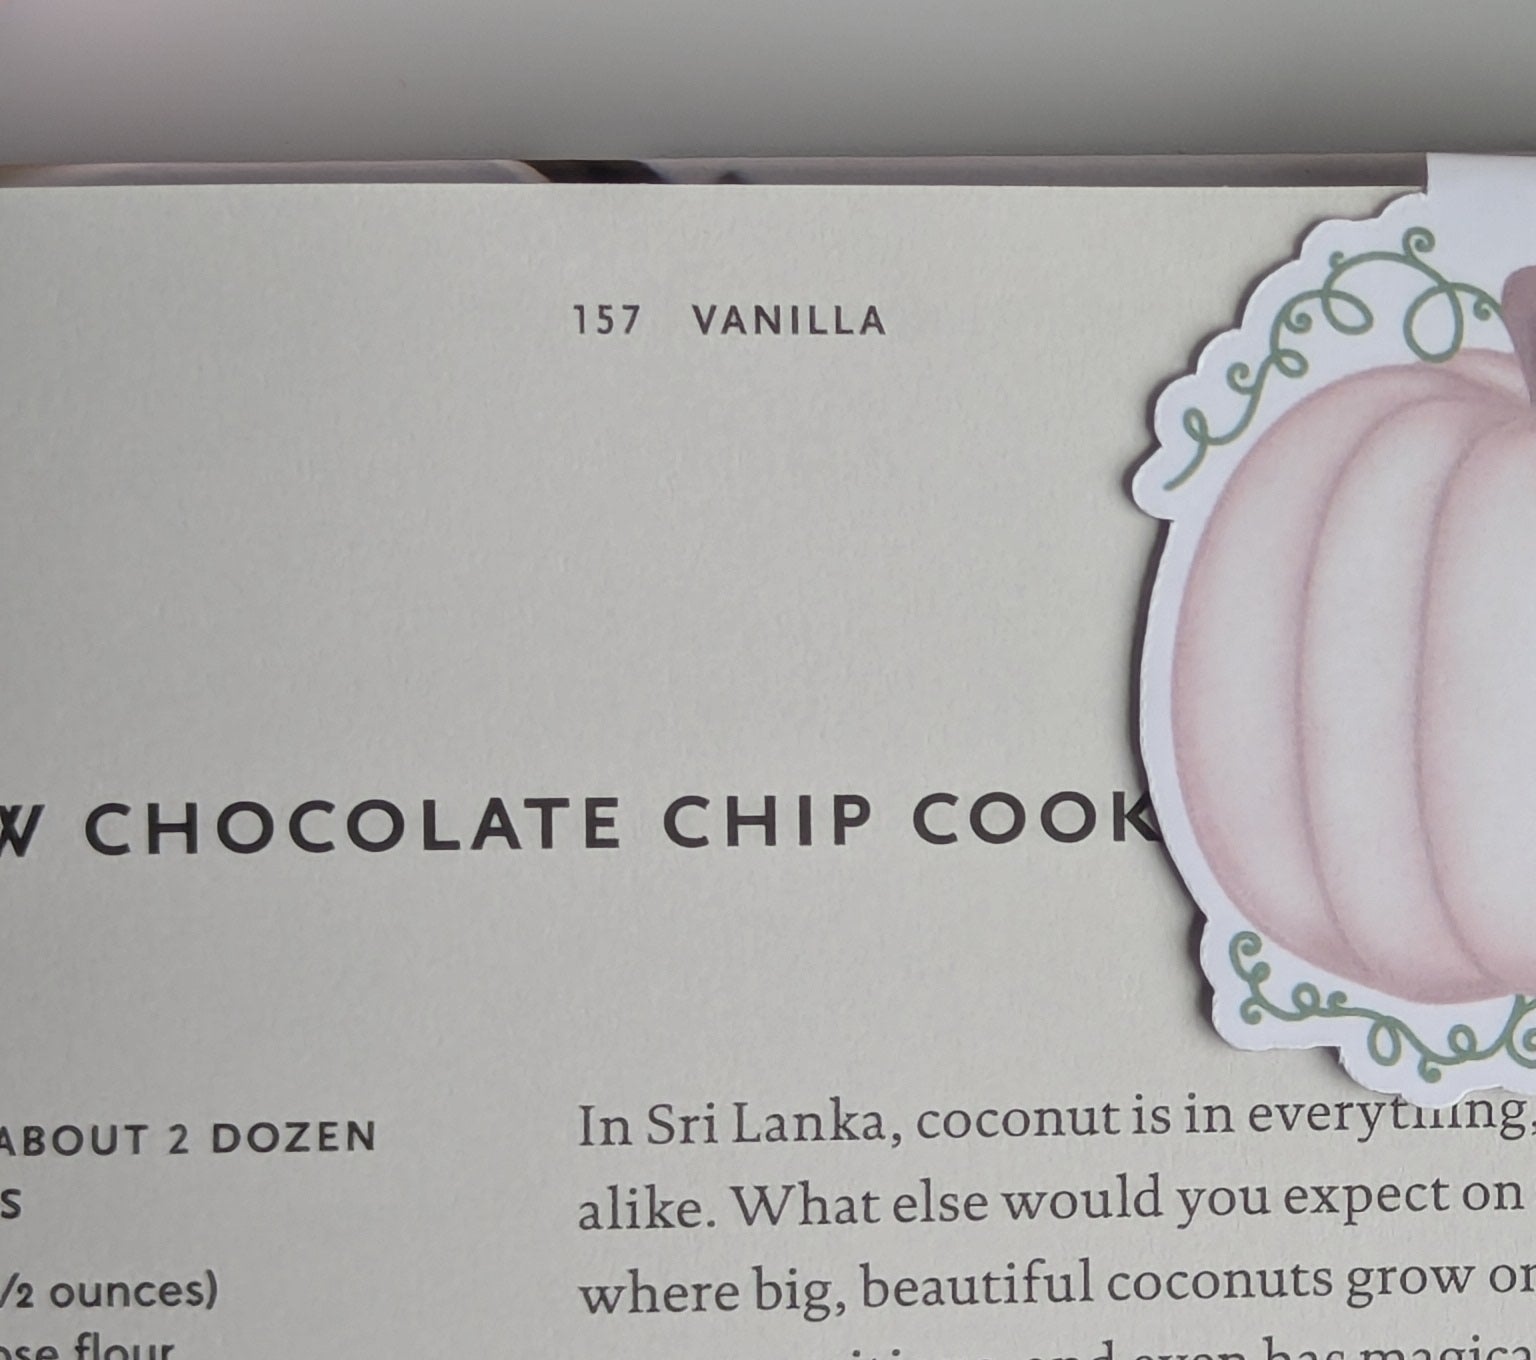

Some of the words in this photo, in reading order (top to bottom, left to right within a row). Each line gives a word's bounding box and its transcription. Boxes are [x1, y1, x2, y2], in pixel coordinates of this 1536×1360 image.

[573, 304, 640, 334] 157
[692, 304, 885, 335] VANILLA
[85, 797, 619, 856] CHOCOLATE
[663, 794, 871, 848] CHIP
[169, 1124, 188, 1154] 2
[212, 1121, 374, 1154] DOZEN
[579, 1105, 632, 1146] In
[648, 1102, 718, 1144] Sri
[733, 1096, 901, 1148] Lanka,
[917, 1103, 1120, 1139] coconut
[1132, 1094, 1171, 1134] is
[1185, 1092, 1235, 1133] in
[579, 1184, 715, 1230] alike.
[729, 1180, 880, 1226] What
[893, 1177, 988, 1223] else
[1001, 1172, 1163, 1220] would
[1176, 1187, 1271, 1229] you
[1284, 1178, 1450, 1226] expect
[1462, 1182, 1524, 1211] on
[50, 1269, 217, 1310] ounces)
